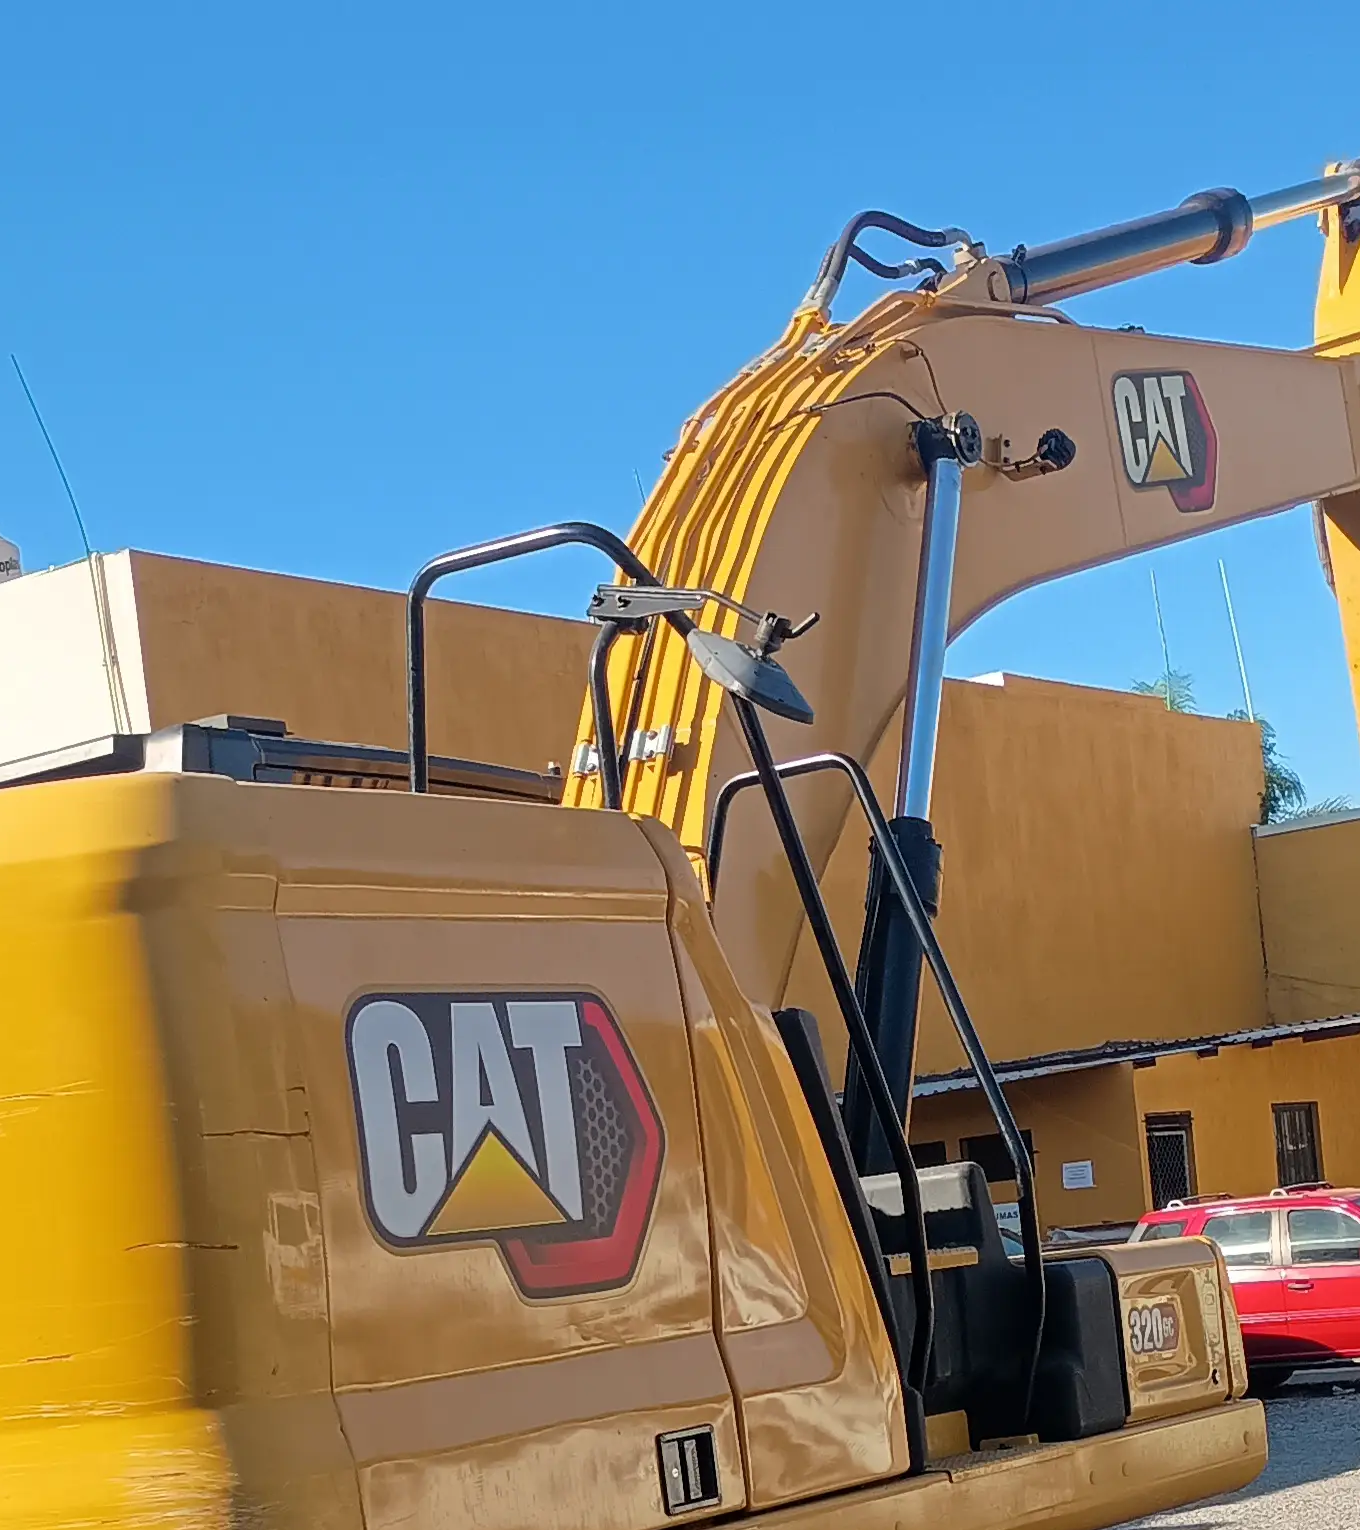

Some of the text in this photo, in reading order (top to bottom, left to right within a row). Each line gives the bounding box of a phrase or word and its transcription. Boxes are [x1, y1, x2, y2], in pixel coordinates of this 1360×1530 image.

[1114, 375, 1193, 484] CAT
[351, 1000, 584, 1238] CAT
[1130, 1307, 1174, 1352] 320 GC
